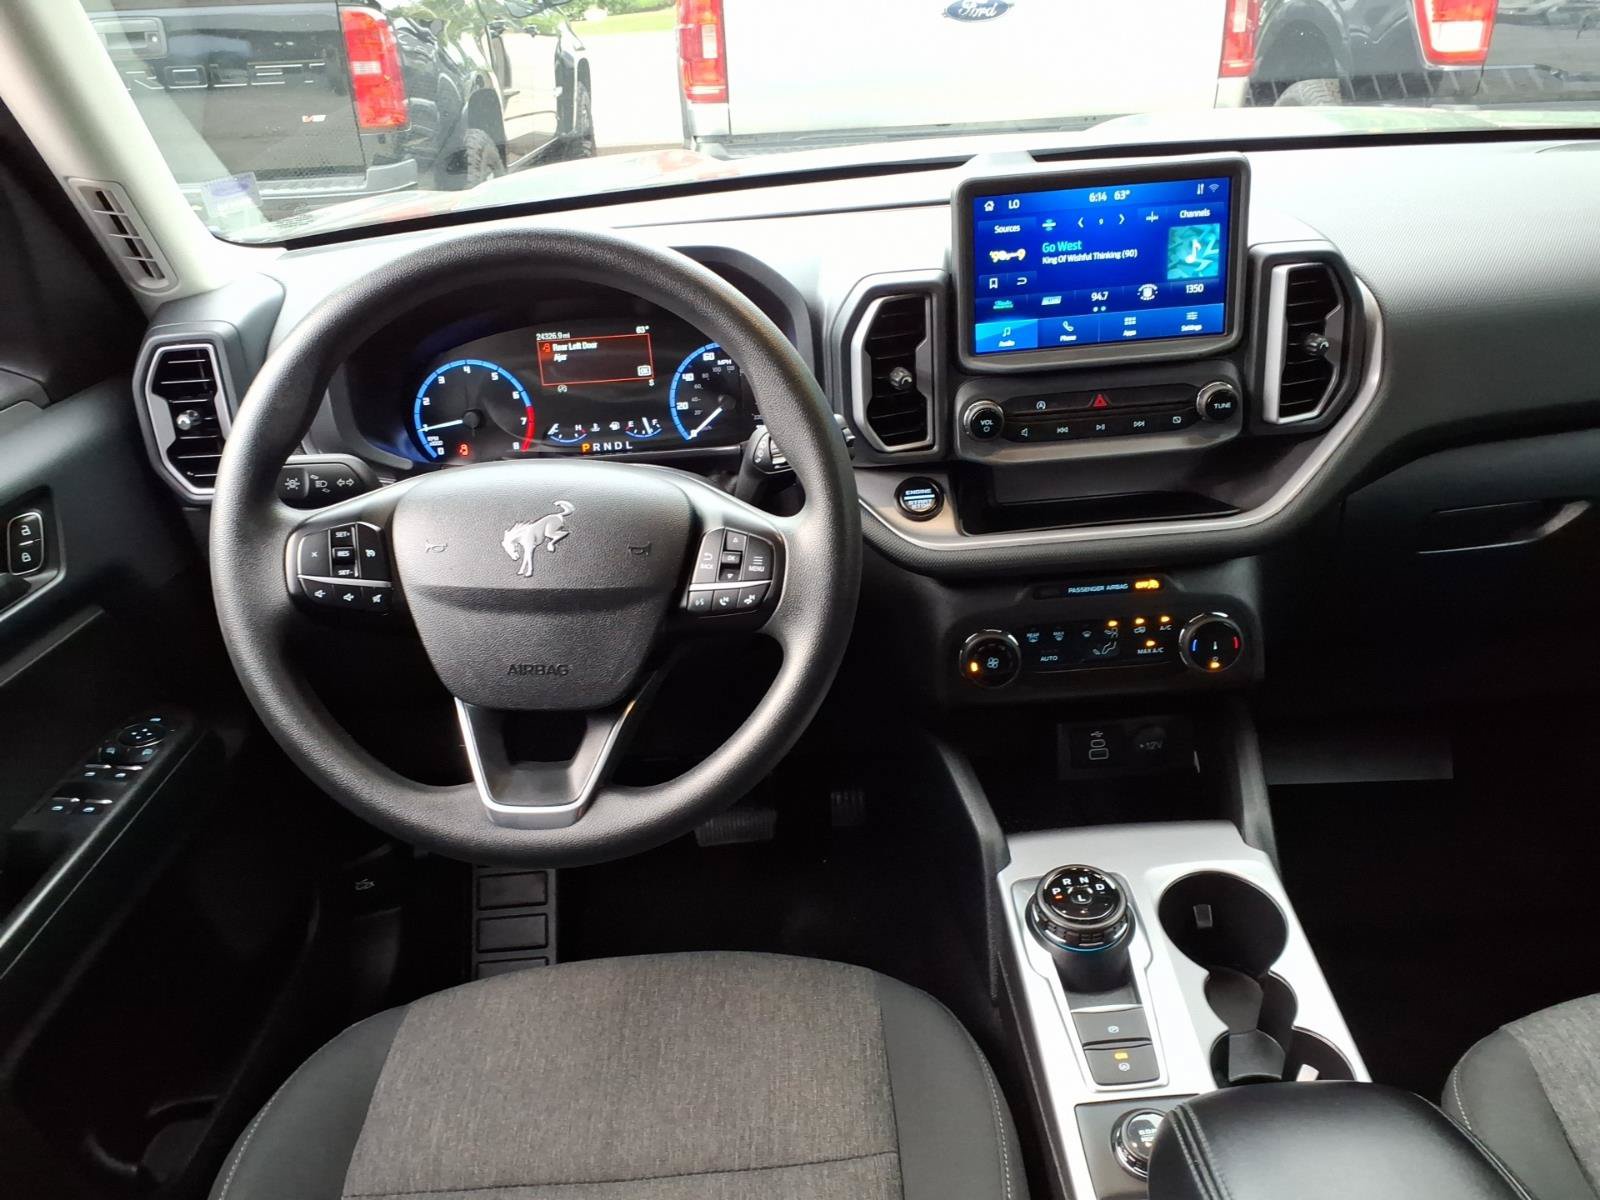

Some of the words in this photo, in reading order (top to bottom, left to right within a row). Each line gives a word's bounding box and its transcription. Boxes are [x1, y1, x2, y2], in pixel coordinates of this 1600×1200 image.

[958, 1, 999, 18] Ford
[1088, 191, 1107, 202] 6:14
[1114, 189, 1131, 200] 63°
[1179, 208, 1211, 218] Channels
[993, 225, 1021, 234] Sources
[1042, 243, 1056, 253] Go
[1057, 240, 1082, 251] West
[1042, 256, 1058, 265] King
[1058, 254, 1067, 263] Of
[1067, 253, 1093, 262] Wishful
[1093, 251, 1121, 260] Thinking
[1121, 249, 1138, 259] (90)
[1186, 283, 1204, 293] 1350
[1091, 291, 1108, 301] 94.7
[552, 343, 567, 351] Rear
[568, 342, 581, 350] Left
[582, 341, 598, 349] Door
[703, 352, 715, 360] 60
[463, 366, 471, 374] 4
[438, 376, 445, 384] 3
[491, 372, 499, 381] 5
[682, 373, 694, 381] 40
[512, 391, 520, 400] 6
[422, 397, 430, 406] 2
[676, 402, 688, 410] 20
[520, 417, 528, 425] 7
[512, 442, 520, 450] 8
[582, 443, 590, 451] P
[592, 443, 600, 451] R
[603, 442, 612, 450] N
[614, 441, 623, 449] D
[626, 441, 633, 449] L
[437, 447, 445, 455] 0
[507, 664, 570, 676] AIRBAG
[1062, 878, 1072, 886] R
[1079, 876, 1090, 884] N
[1051, 887, 1062, 895] P
[1095, 883, 1106, 891] D
[1077, 894, 1086, 902] L
